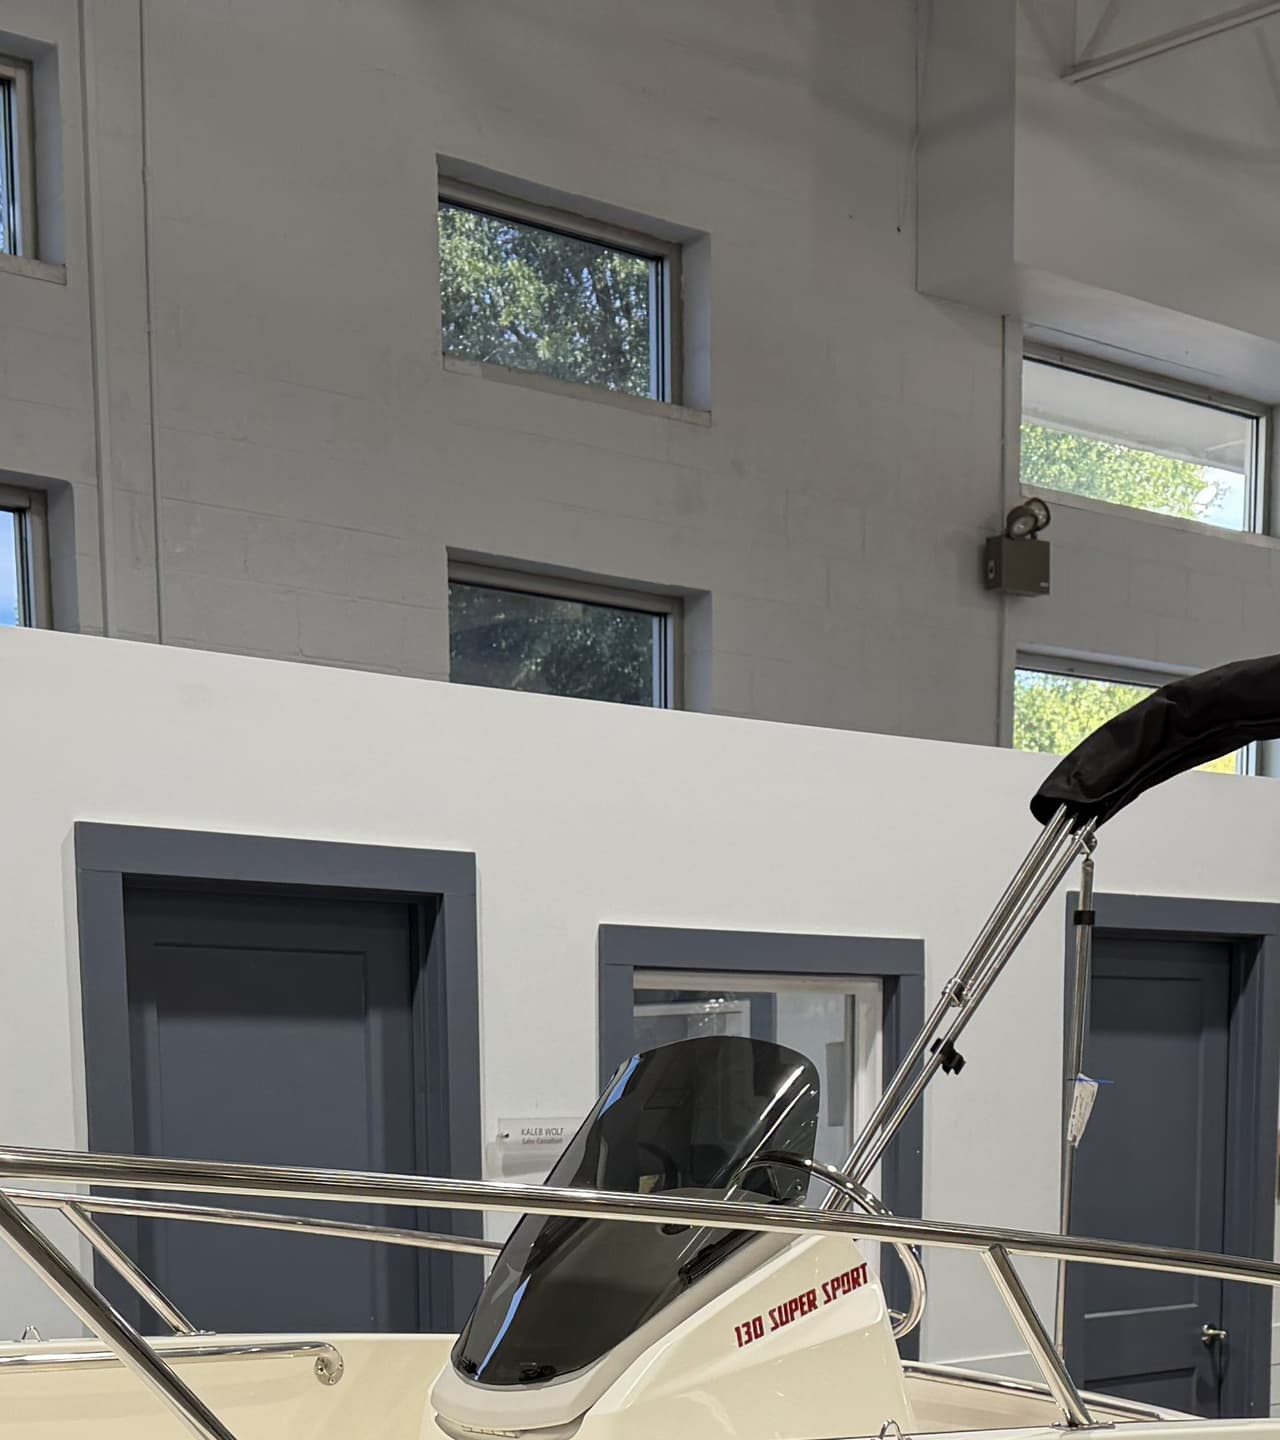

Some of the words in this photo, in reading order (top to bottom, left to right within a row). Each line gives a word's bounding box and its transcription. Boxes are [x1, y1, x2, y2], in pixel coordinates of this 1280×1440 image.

[734, 1315, 764, 1348] 130
[768, 1288, 818, 1332] SUPER
[821, 1262, 868, 1305] SPORT
